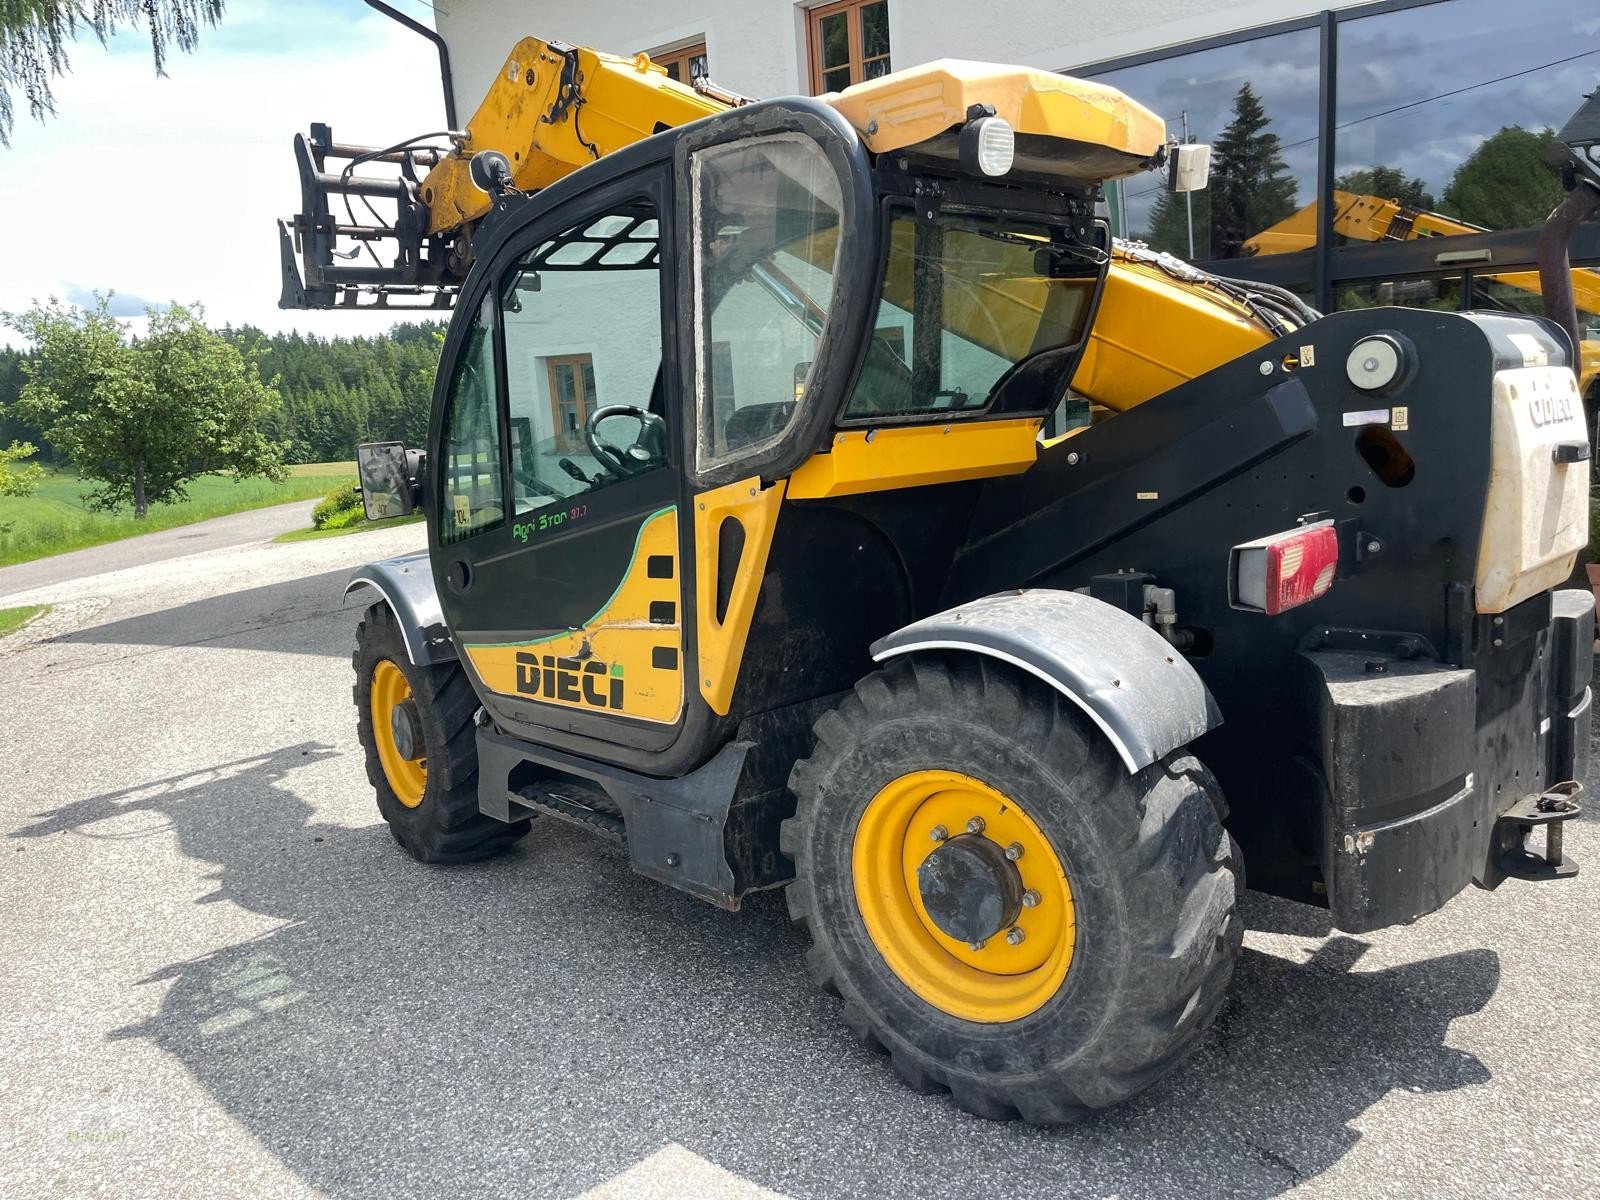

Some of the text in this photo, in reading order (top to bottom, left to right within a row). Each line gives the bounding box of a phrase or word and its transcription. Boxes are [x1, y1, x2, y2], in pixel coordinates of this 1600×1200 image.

[513, 504, 588, 543] Agri Star 37.7
[516, 651, 624, 709] DIECI
